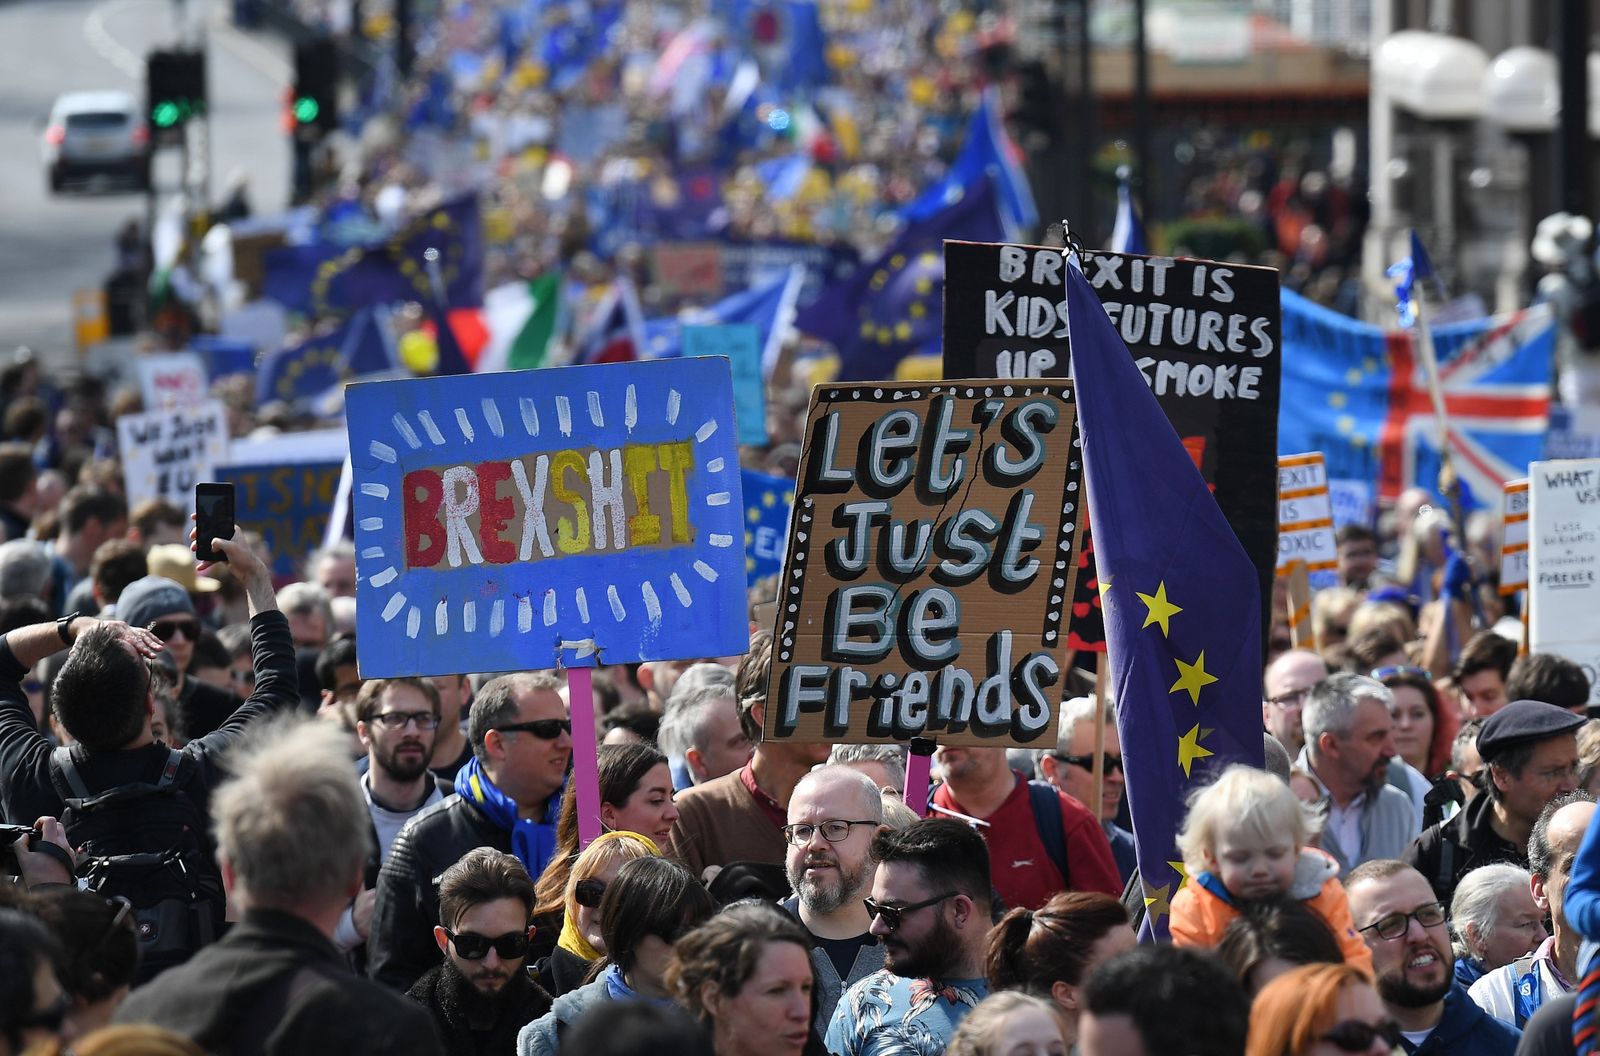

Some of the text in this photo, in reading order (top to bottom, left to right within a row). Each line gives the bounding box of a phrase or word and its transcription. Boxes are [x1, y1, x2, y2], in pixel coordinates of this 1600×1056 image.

[1193, 265, 1235, 303] IS
[996, 349, 1056, 378] UP
[158, 470, 193, 494] EU
[811, 394, 1056, 498] Let's
[1544, 470, 1593, 488] WHAT
[403, 439, 694, 571] BREXSHIT
[827, 490, 1044, 589] Just
[826, 583, 960, 666] Be
[778, 630, 1059, 737] Friends
